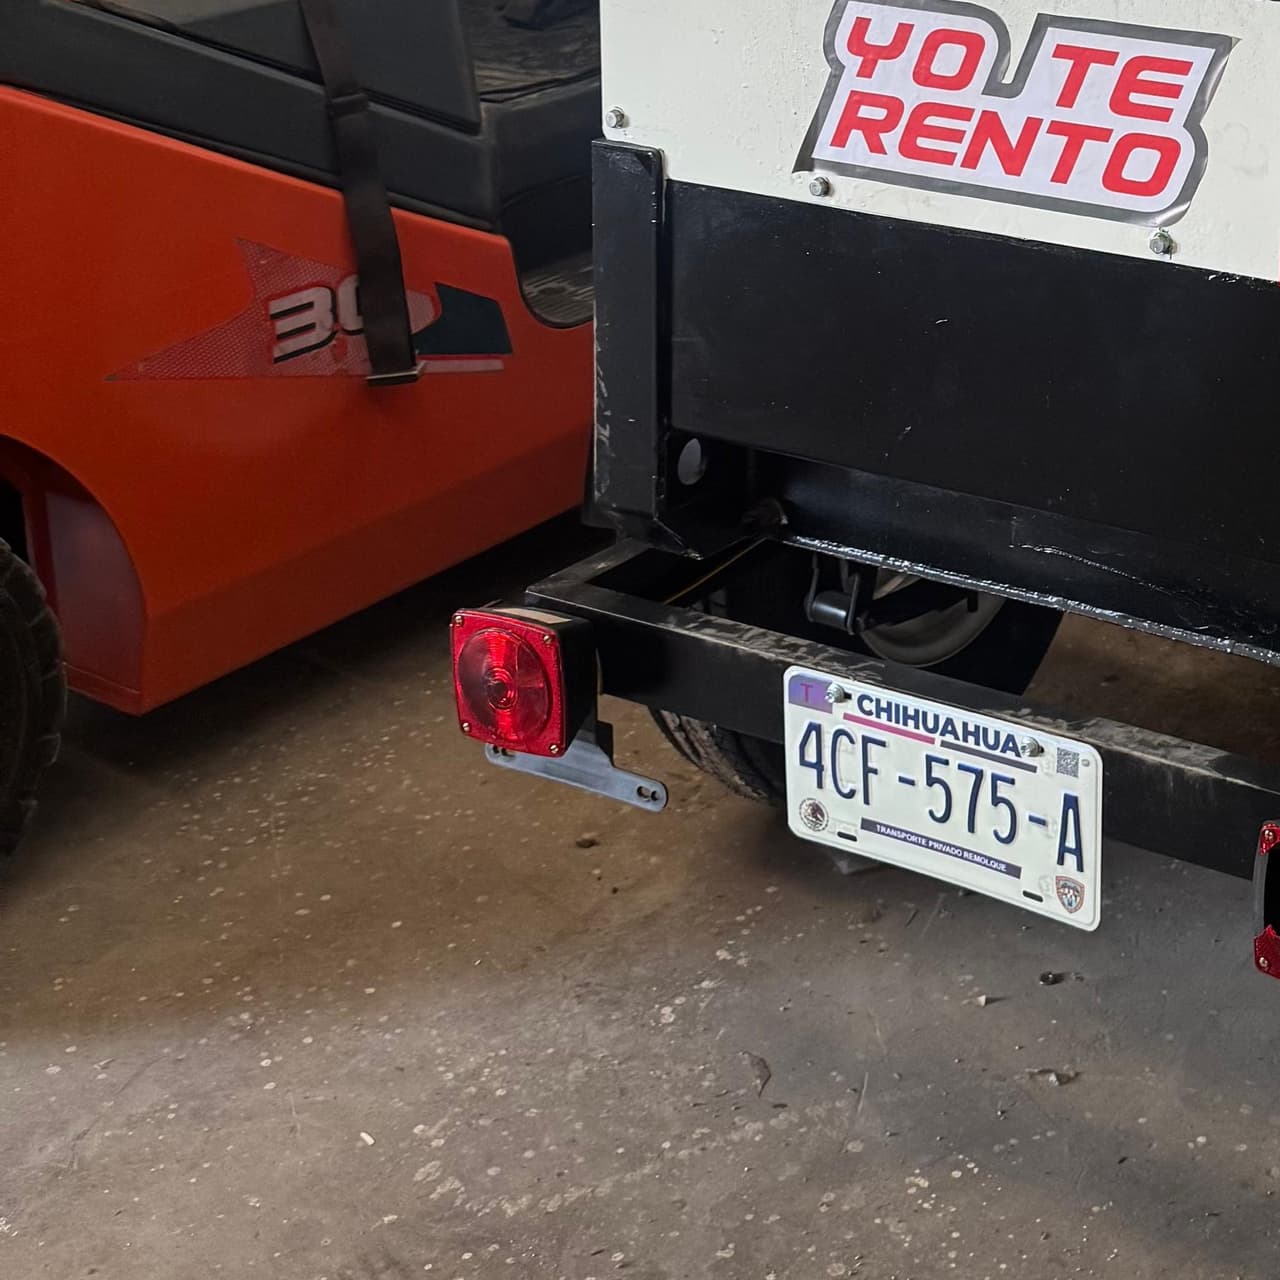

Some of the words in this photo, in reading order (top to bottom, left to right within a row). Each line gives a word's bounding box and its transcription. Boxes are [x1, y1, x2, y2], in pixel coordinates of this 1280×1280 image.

[846, 16, 985, 91] YO
[1052, 43, 1195, 123] TE
[828, 90, 1181, 198] RENTO
[857, 694, 1022, 758] CHIHUAHUA
[799, 721, 1085, 873] 4CF-575-A
[876, 824, 928, 847] TRANSPORTE
[928, 839, 963, 858] PRIVADO
[963, 851, 1007, 873] REMOLQUE
